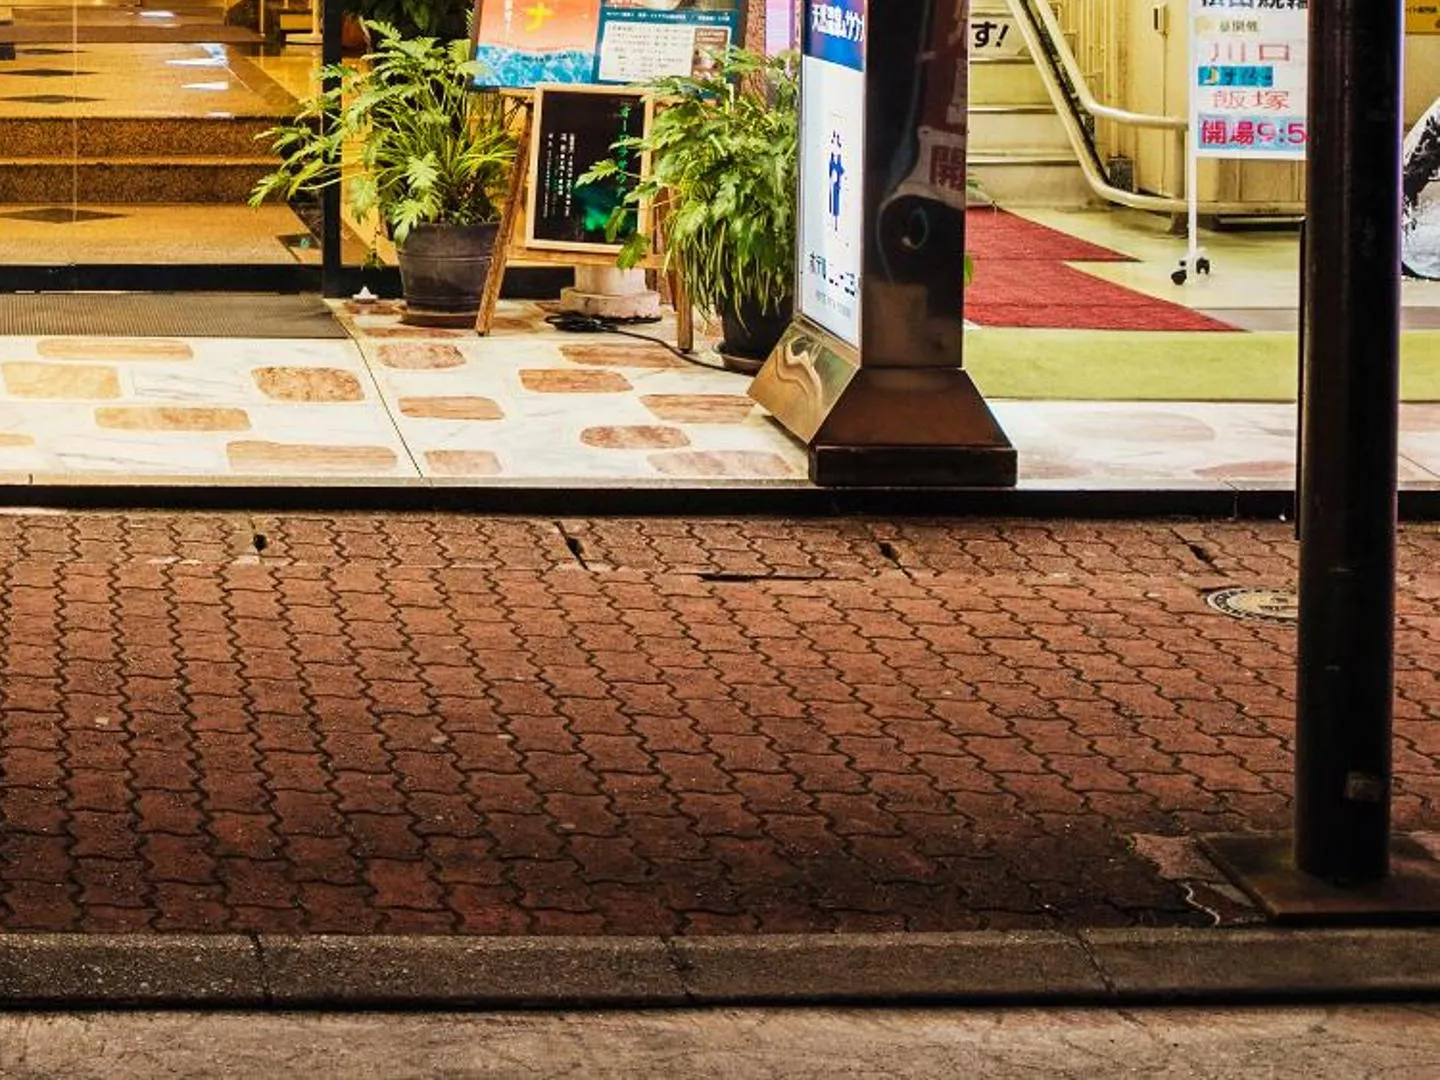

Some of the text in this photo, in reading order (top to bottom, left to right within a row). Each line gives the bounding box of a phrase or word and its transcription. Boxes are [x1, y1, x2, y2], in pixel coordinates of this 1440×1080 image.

[1210, 42, 1290, 62] 川口
[1212, 90, 1290, 109] 飯塚
[1202, 120, 1310, 146] 開場9:5
